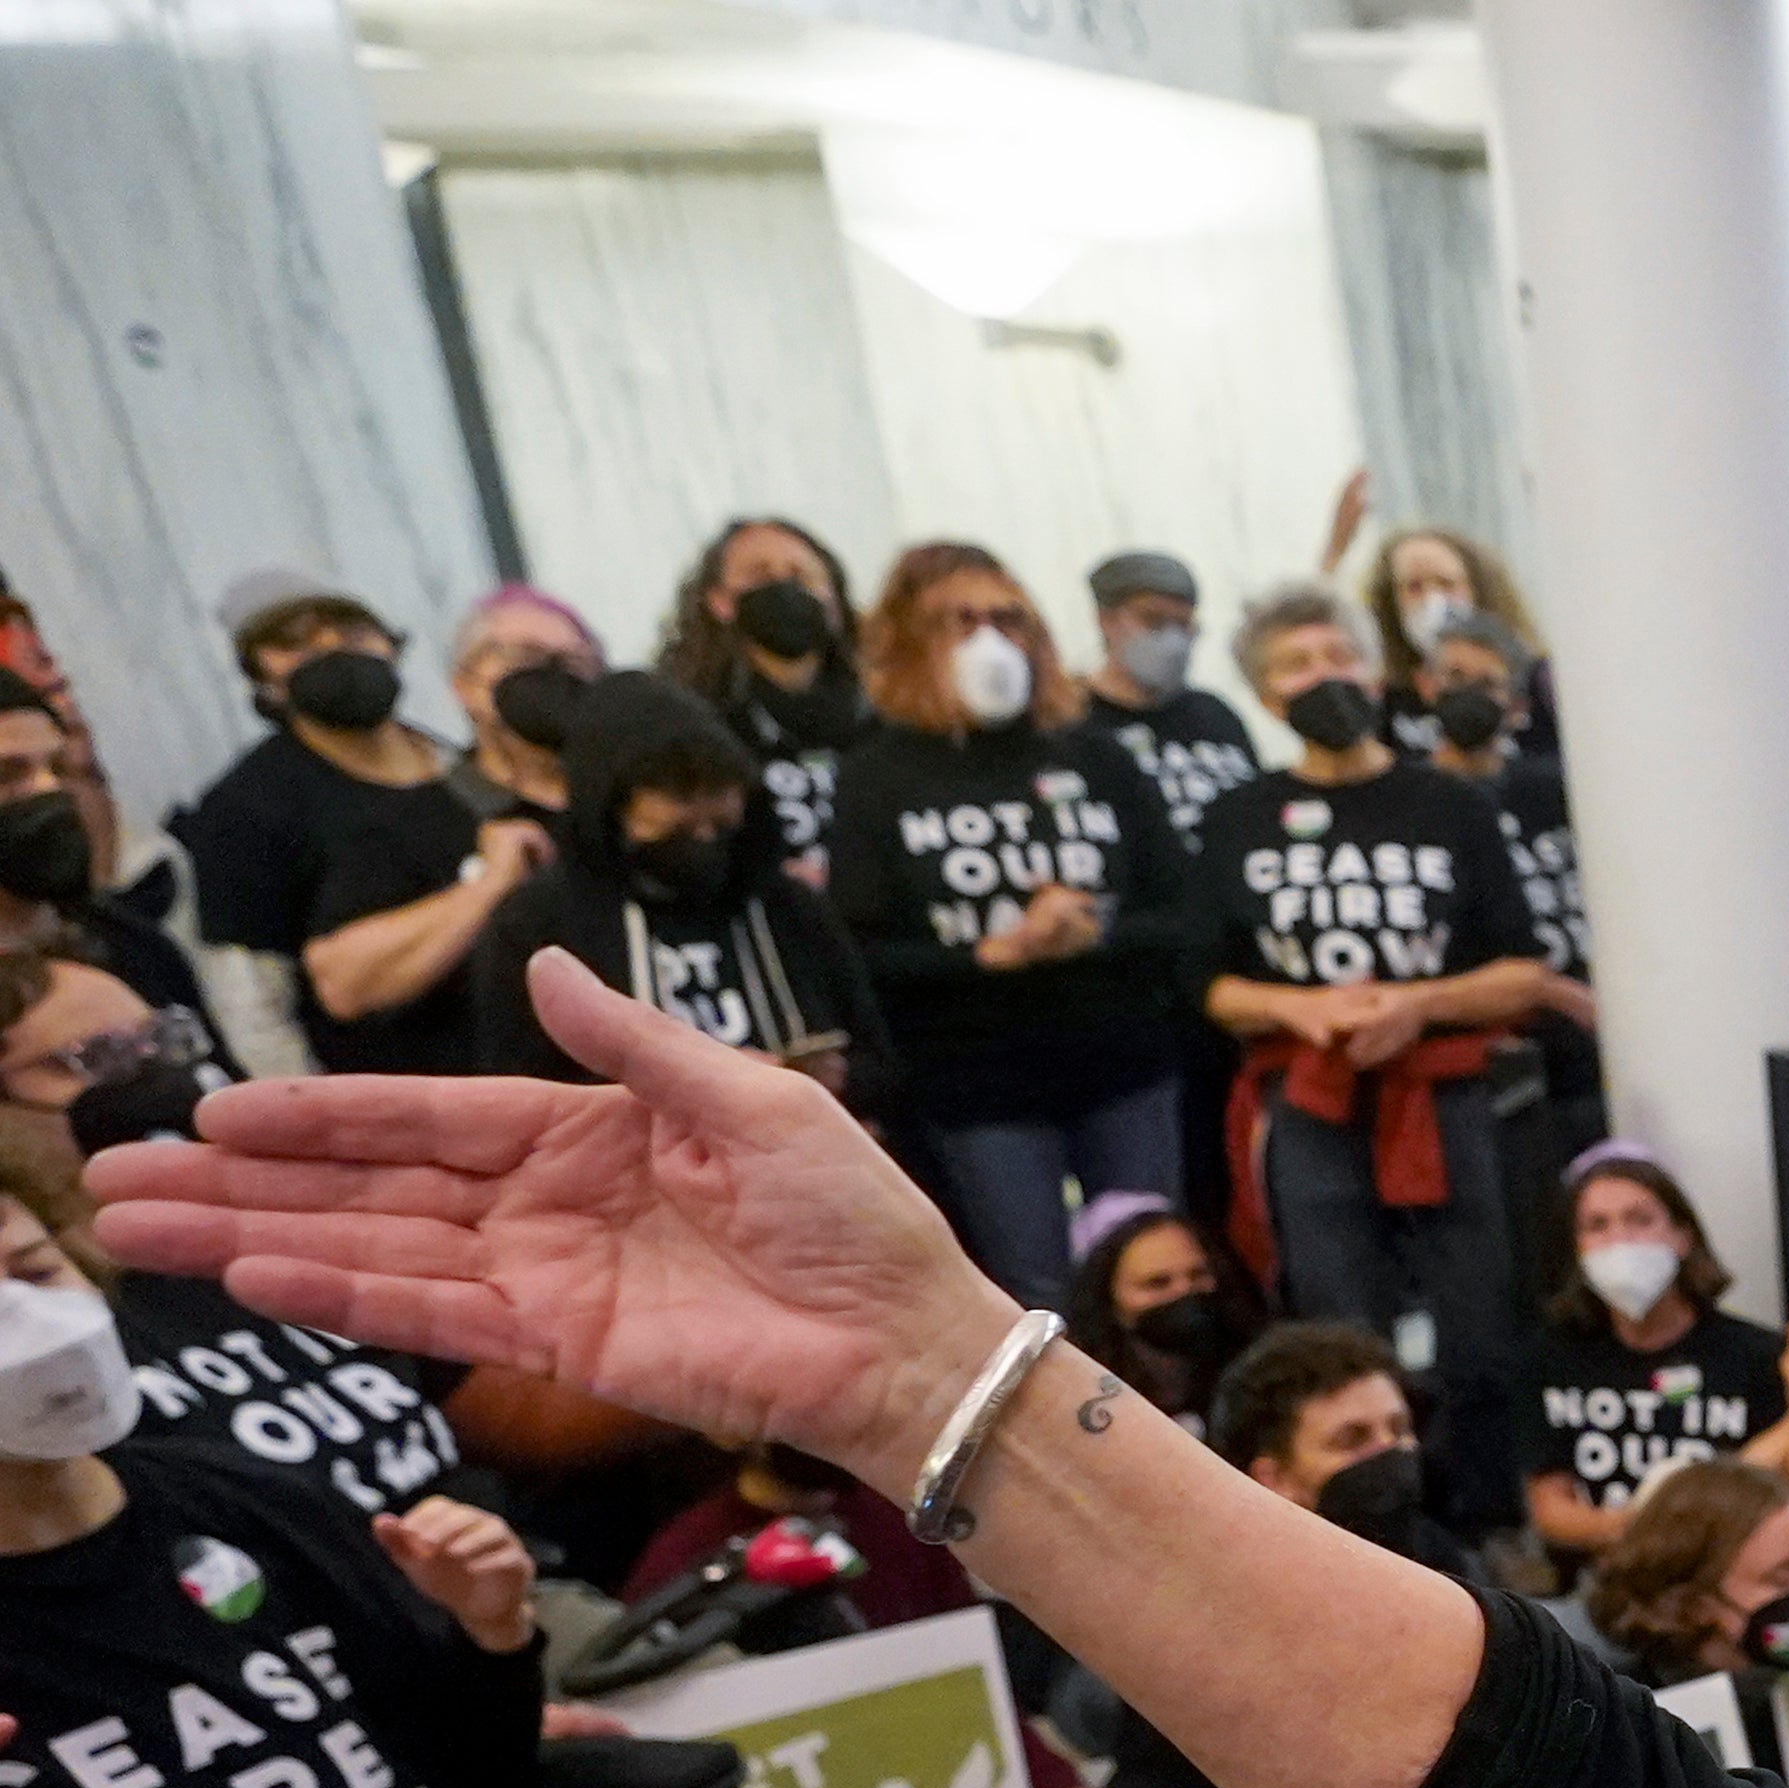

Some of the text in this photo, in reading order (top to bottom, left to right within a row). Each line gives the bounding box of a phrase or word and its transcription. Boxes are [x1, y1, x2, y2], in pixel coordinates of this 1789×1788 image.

[900, 802, 1033, 855] NOT
[941, 839, 1106, 896] OUR
[1242, 840, 1458, 895] CEASE
[1268, 883, 1427, 936] FIRE
[1252, 921, 1453, 987] NOW
[230, 1362, 422, 1464] OUR
[1543, 1385, 1656, 1433] NOT
